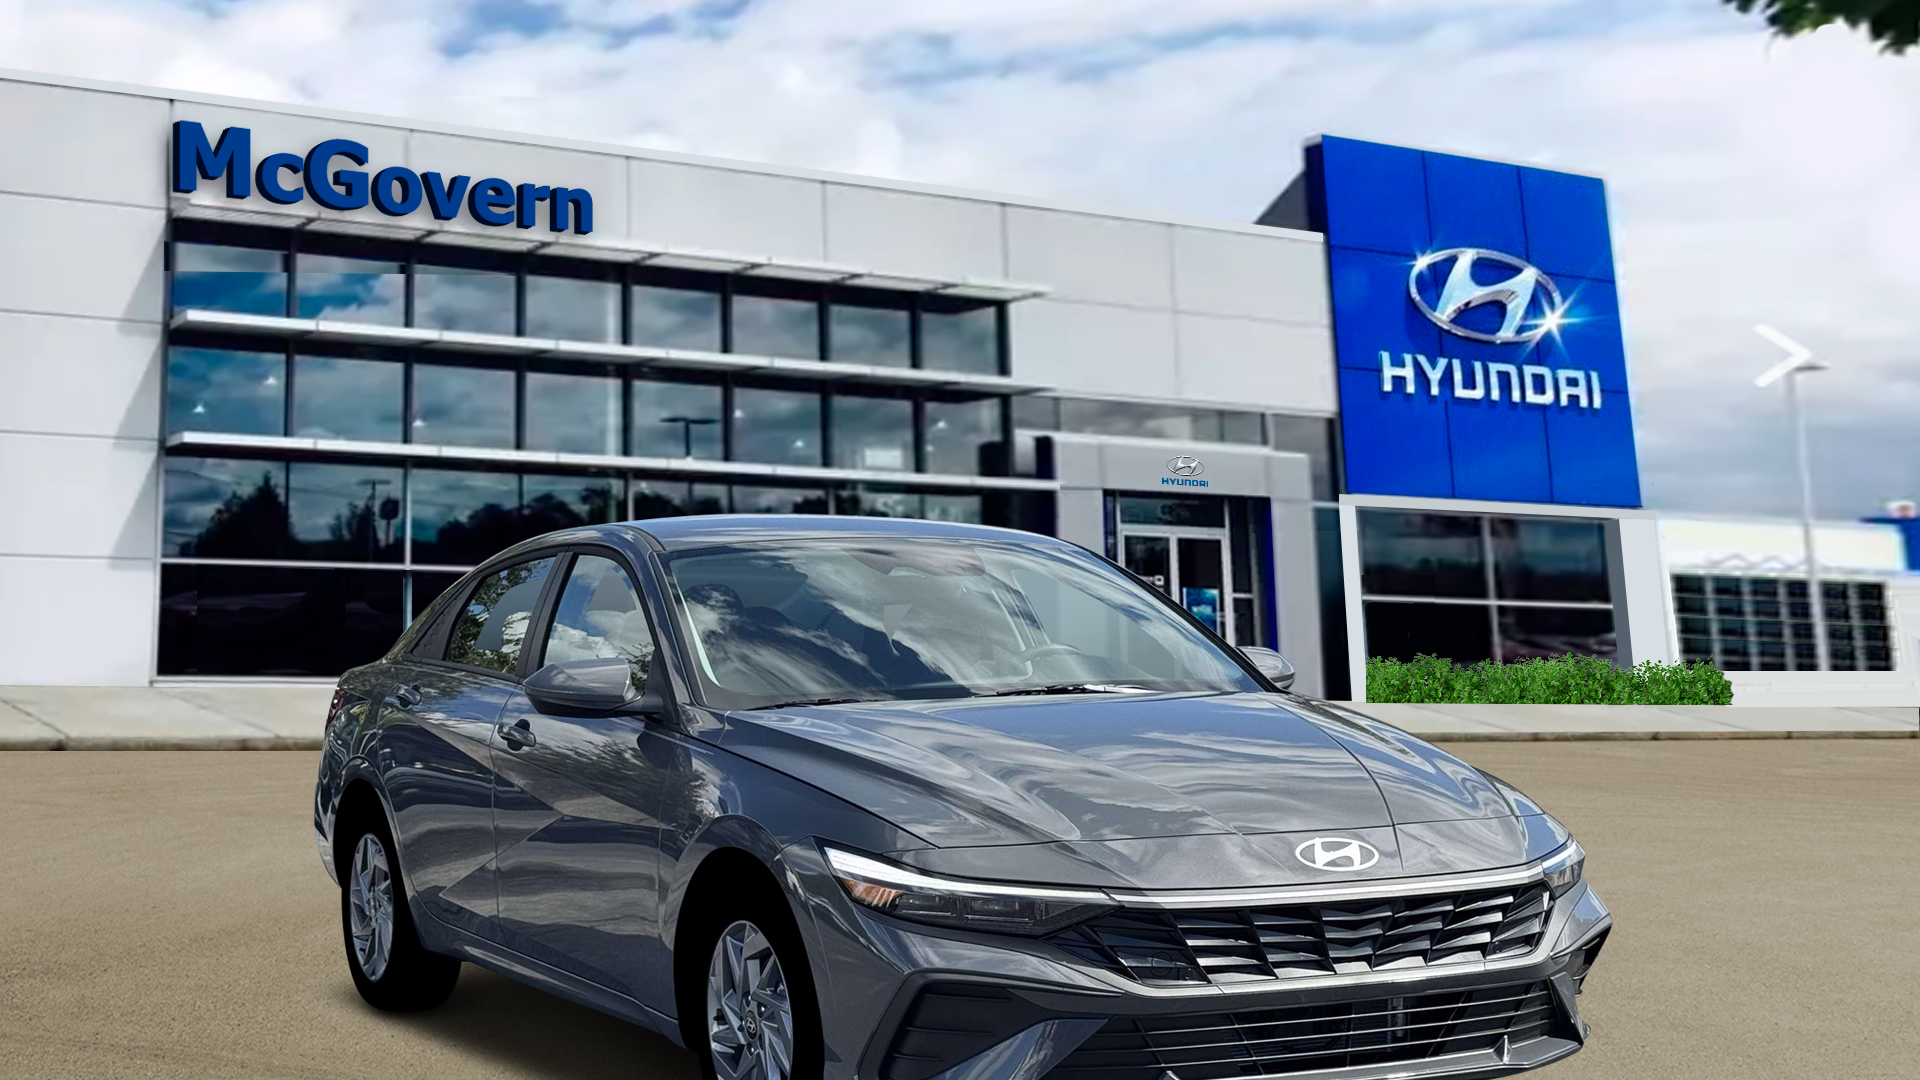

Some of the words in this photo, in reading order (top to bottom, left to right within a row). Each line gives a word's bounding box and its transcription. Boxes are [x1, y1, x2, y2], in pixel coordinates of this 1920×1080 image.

[172, 119, 594, 236] McGovern
[1378, 350, 1602, 410] HYUNDAI
[1161, 477, 1209, 488] HYUNDAI
